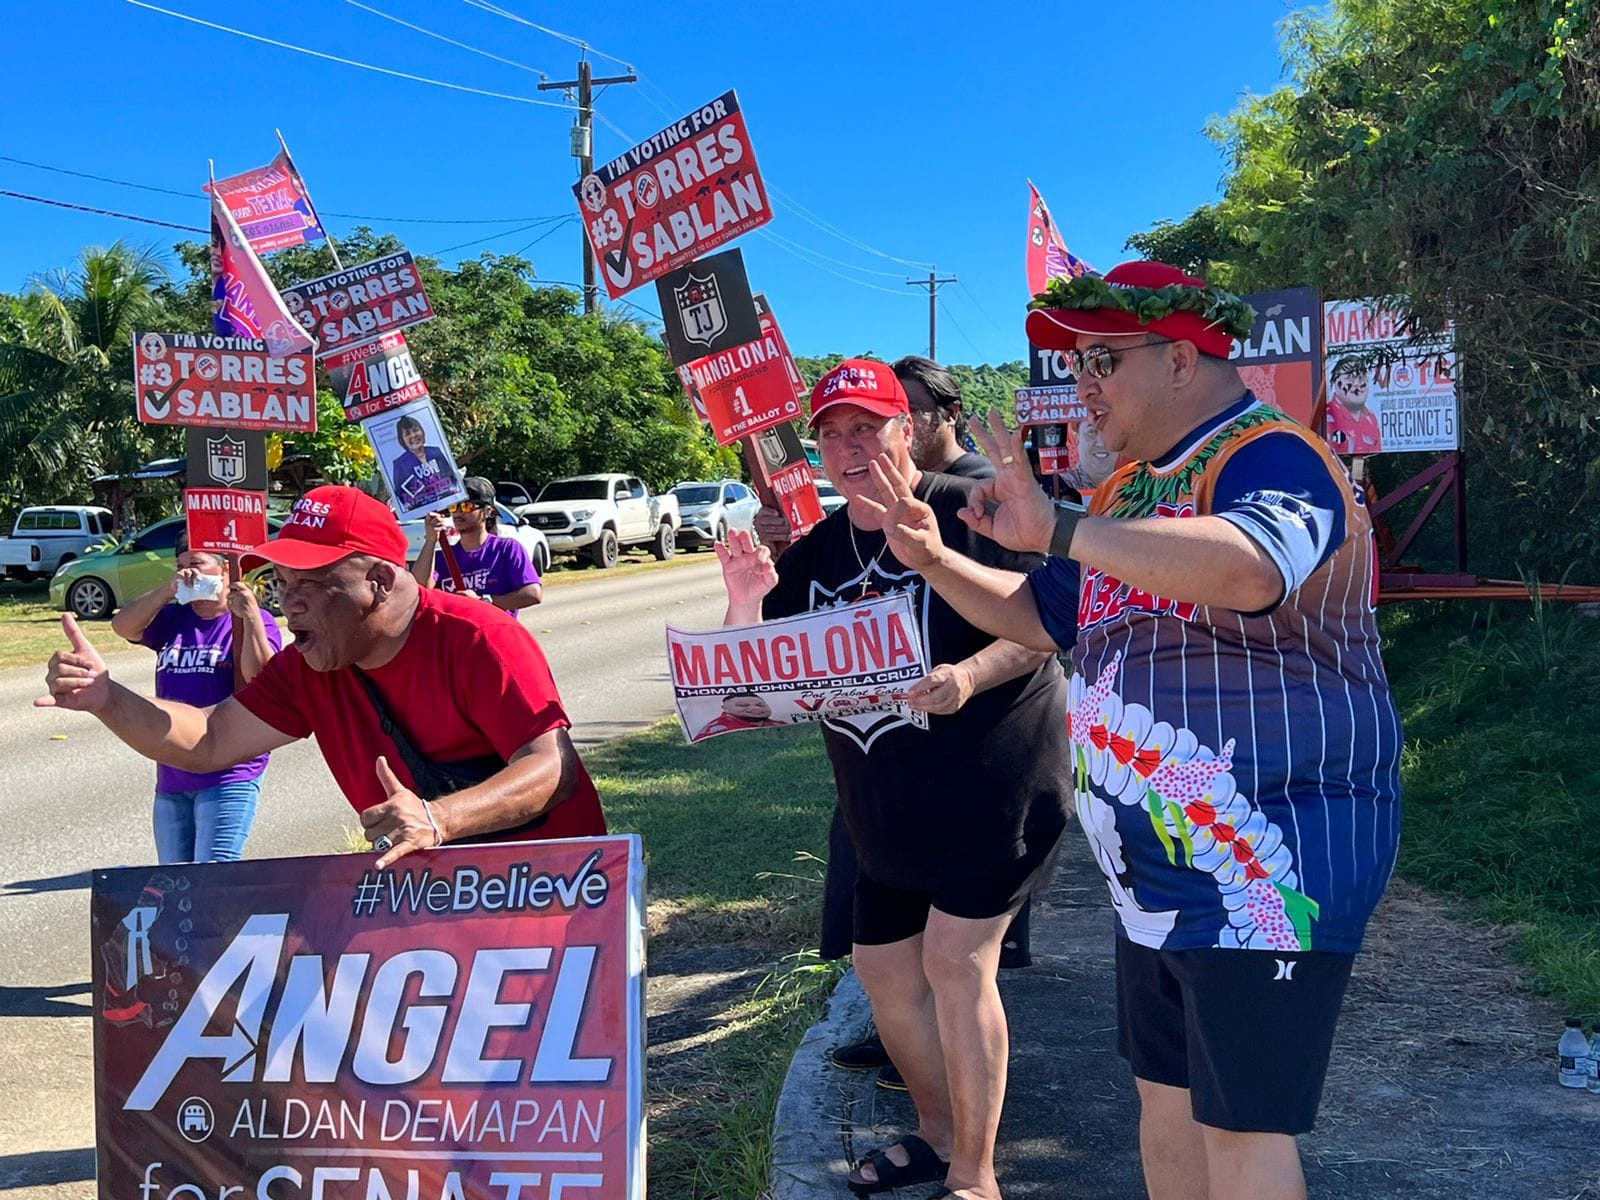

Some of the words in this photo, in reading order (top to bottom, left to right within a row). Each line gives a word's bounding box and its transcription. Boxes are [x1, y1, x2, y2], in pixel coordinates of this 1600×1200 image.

[607, 159, 630, 181] I'M
[630, 124, 691, 166] VOTING
[692, 99, 728, 132] FOR
[614, 124, 743, 220] TORRES
[592, 208, 624, 249] #3
[633, 173, 764, 269] SABLAN
[306, 280, 329, 296] I'M
[330, 264, 378, 288] VOTING
[380, 256, 406, 274] FOR
[312, 268, 416, 317] TORRES
[323, 292, 428, 343] SABLAN
[689, 303, 713, 335] TJ
[174, 334, 197, 349] I'M
[201, 336, 265, 352] VOTING
[1229, 316, 1311, 360] LAN
[140, 363, 174, 387] #3
[174, 351, 307, 387] TORRES
[344, 352, 422, 407] ANGEL
[827, 367, 876, 386] TORRES
[366, 401, 380, 413] for
[384, 385, 418, 408] SENATE
[733, 386, 753, 417] #1
[823, 379, 878, 397] SABLAN
[1031, 394, 1080, 406] TORRE
[177, 389, 311, 423] SABLAN
[733, 421, 747, 432] THE
[747, 408, 781, 426] BALLOT
[1031, 407, 1088, 420] SABLAN
[1382, 409, 1441, 438] PRECINCT
[1445, 409, 1453, 435] 5
[218, 457, 237, 478] TJ
[188, 494, 262, 514] MANGLOÑA
[223, 520, 238, 541] #1
[232, 542, 254, 551] BALLOT
[671, 609, 916, 687] MANGLOÑA
[677, 686, 747, 698] THOMAS
[750, 683, 794, 693] JOHN
[831, 675, 875, 688] DELA
[876, 668, 922, 683] CRUZ
[354, 849, 609, 915] #WeBelieve
[123, 914, 613, 1111] ANGEL
[229, 1099, 366, 1140] ALDAN
[381, 1099, 605, 1143] DEMAPAN
